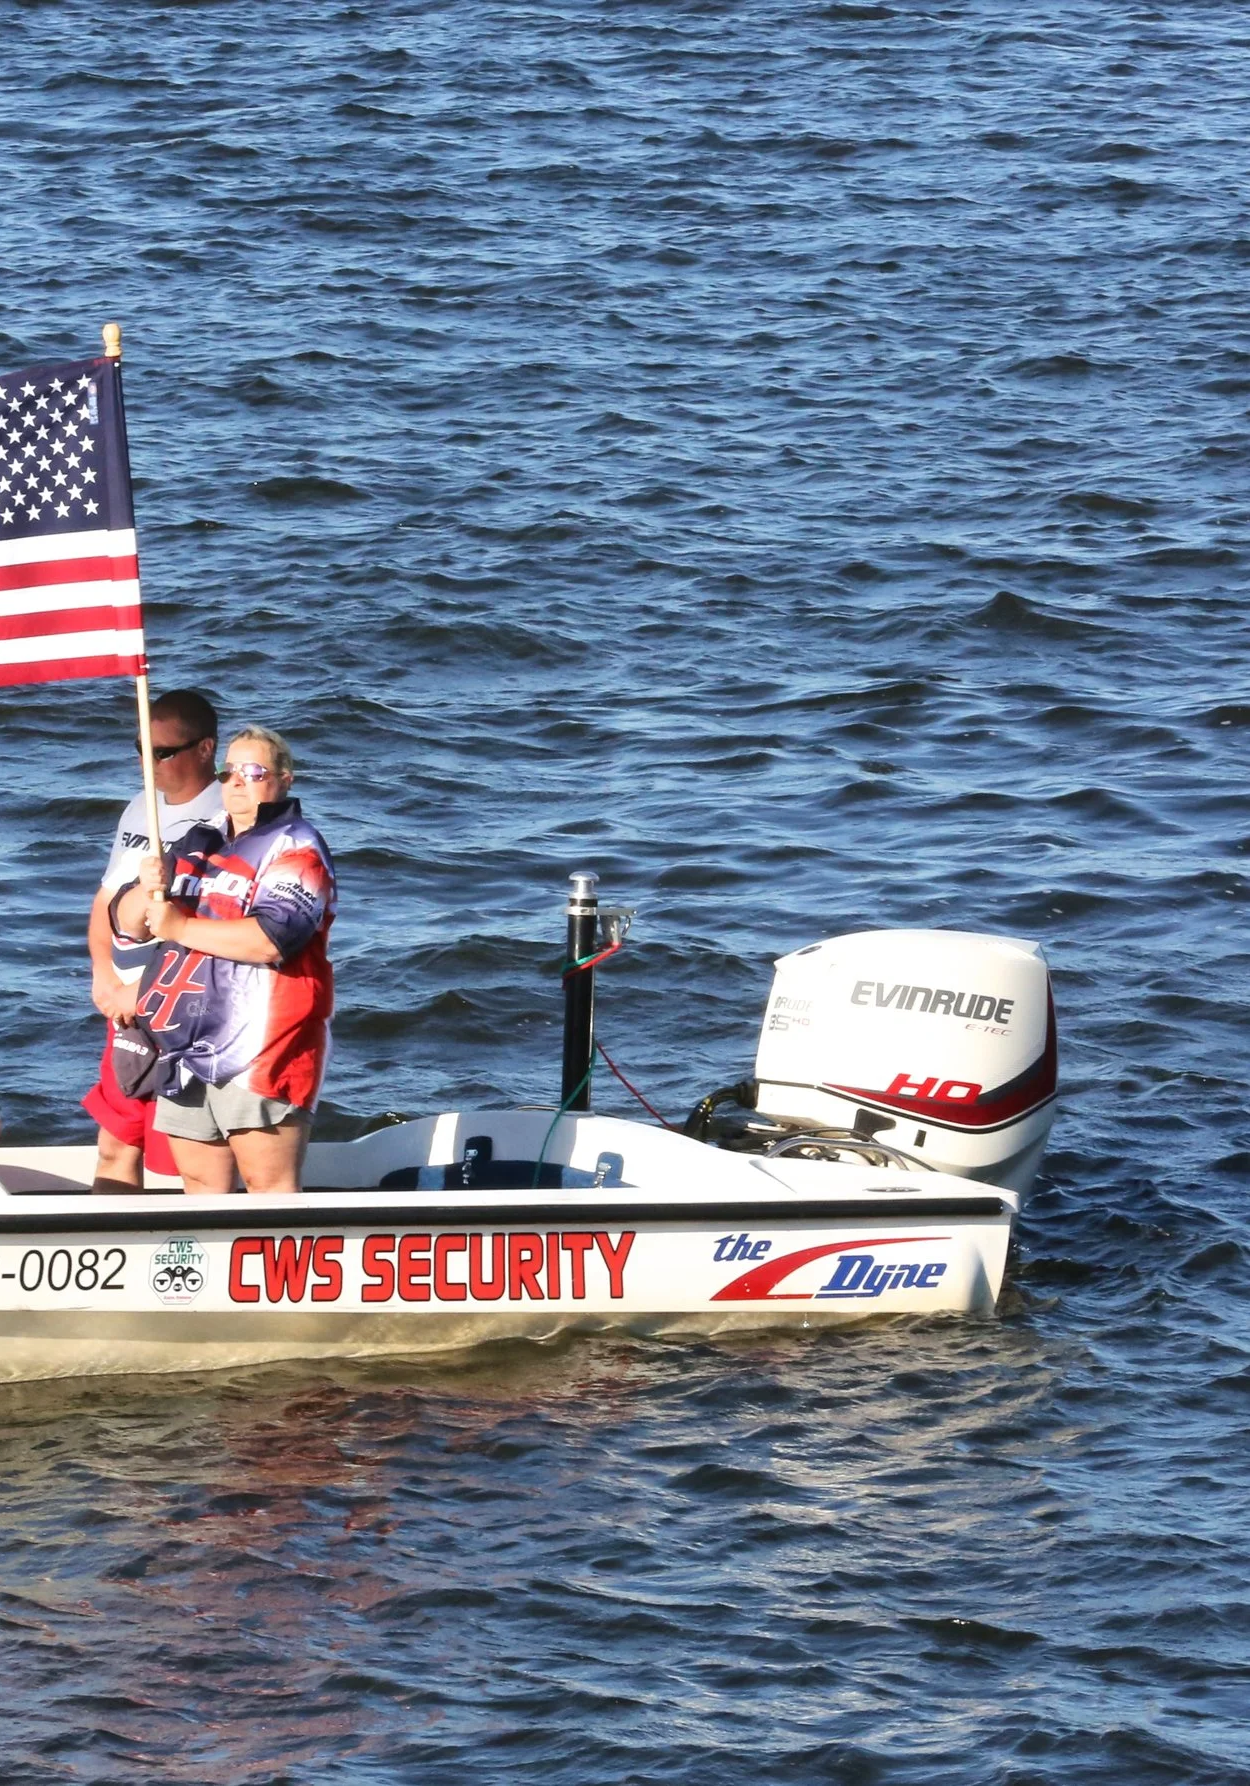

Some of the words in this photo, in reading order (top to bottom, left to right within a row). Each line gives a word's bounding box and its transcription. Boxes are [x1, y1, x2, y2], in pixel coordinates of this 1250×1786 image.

[850, 980, 1015, 1025] EVINRUDE
[965, 1023, 1012, 1037] E-TEC
[885, 1073, 983, 1104] HO
[154, 1253, 204, 1265] SECURITY
[168, 1241, 194, 1253] CWS
[713, 1233, 773, 1262] the
[228, 1235, 345, 1303] CWS
[361, 1231, 637, 1302] SECURITY
[814, 1254, 948, 1299] Dyne
